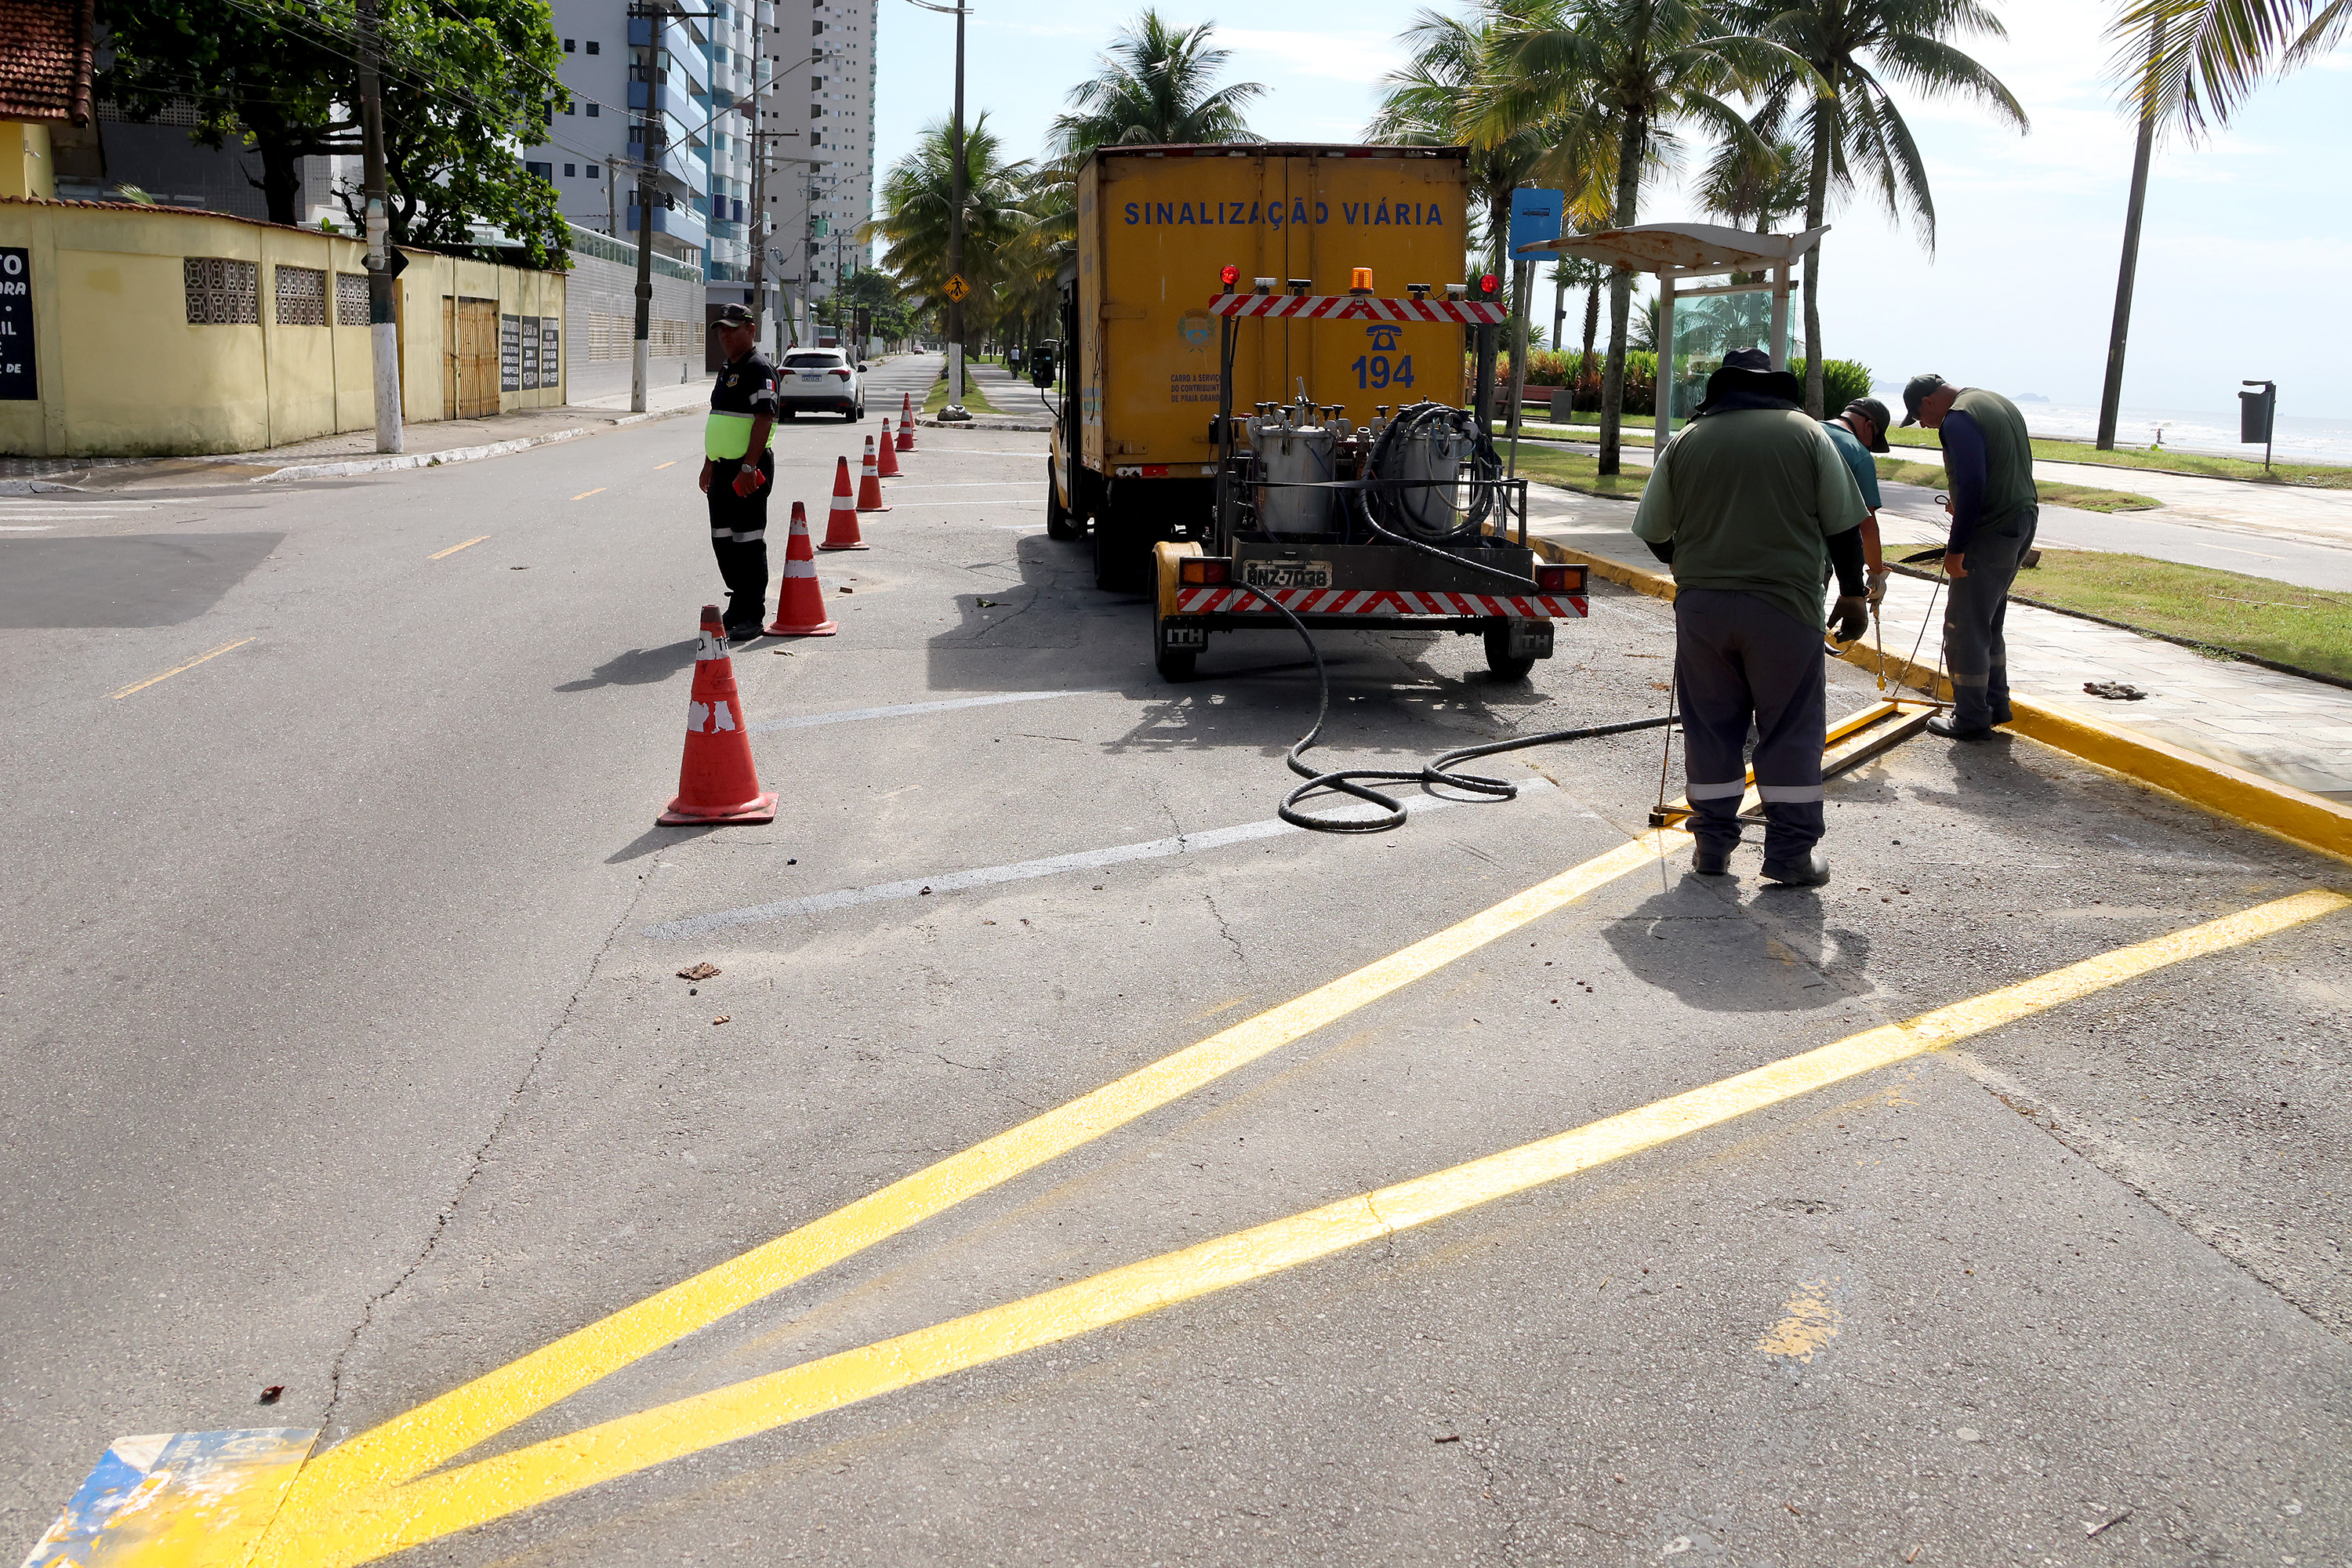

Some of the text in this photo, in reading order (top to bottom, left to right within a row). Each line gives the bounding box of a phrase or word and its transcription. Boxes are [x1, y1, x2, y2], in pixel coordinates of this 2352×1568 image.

[1124, 197, 1443, 230] SINALIZAÇÃO VIÁRIA
[0, 255, 22, 274] O
[6, 364, 21, 373] DE
[1352, 355, 1414, 389] 194
[1167, 629, 1203, 642] ITH
